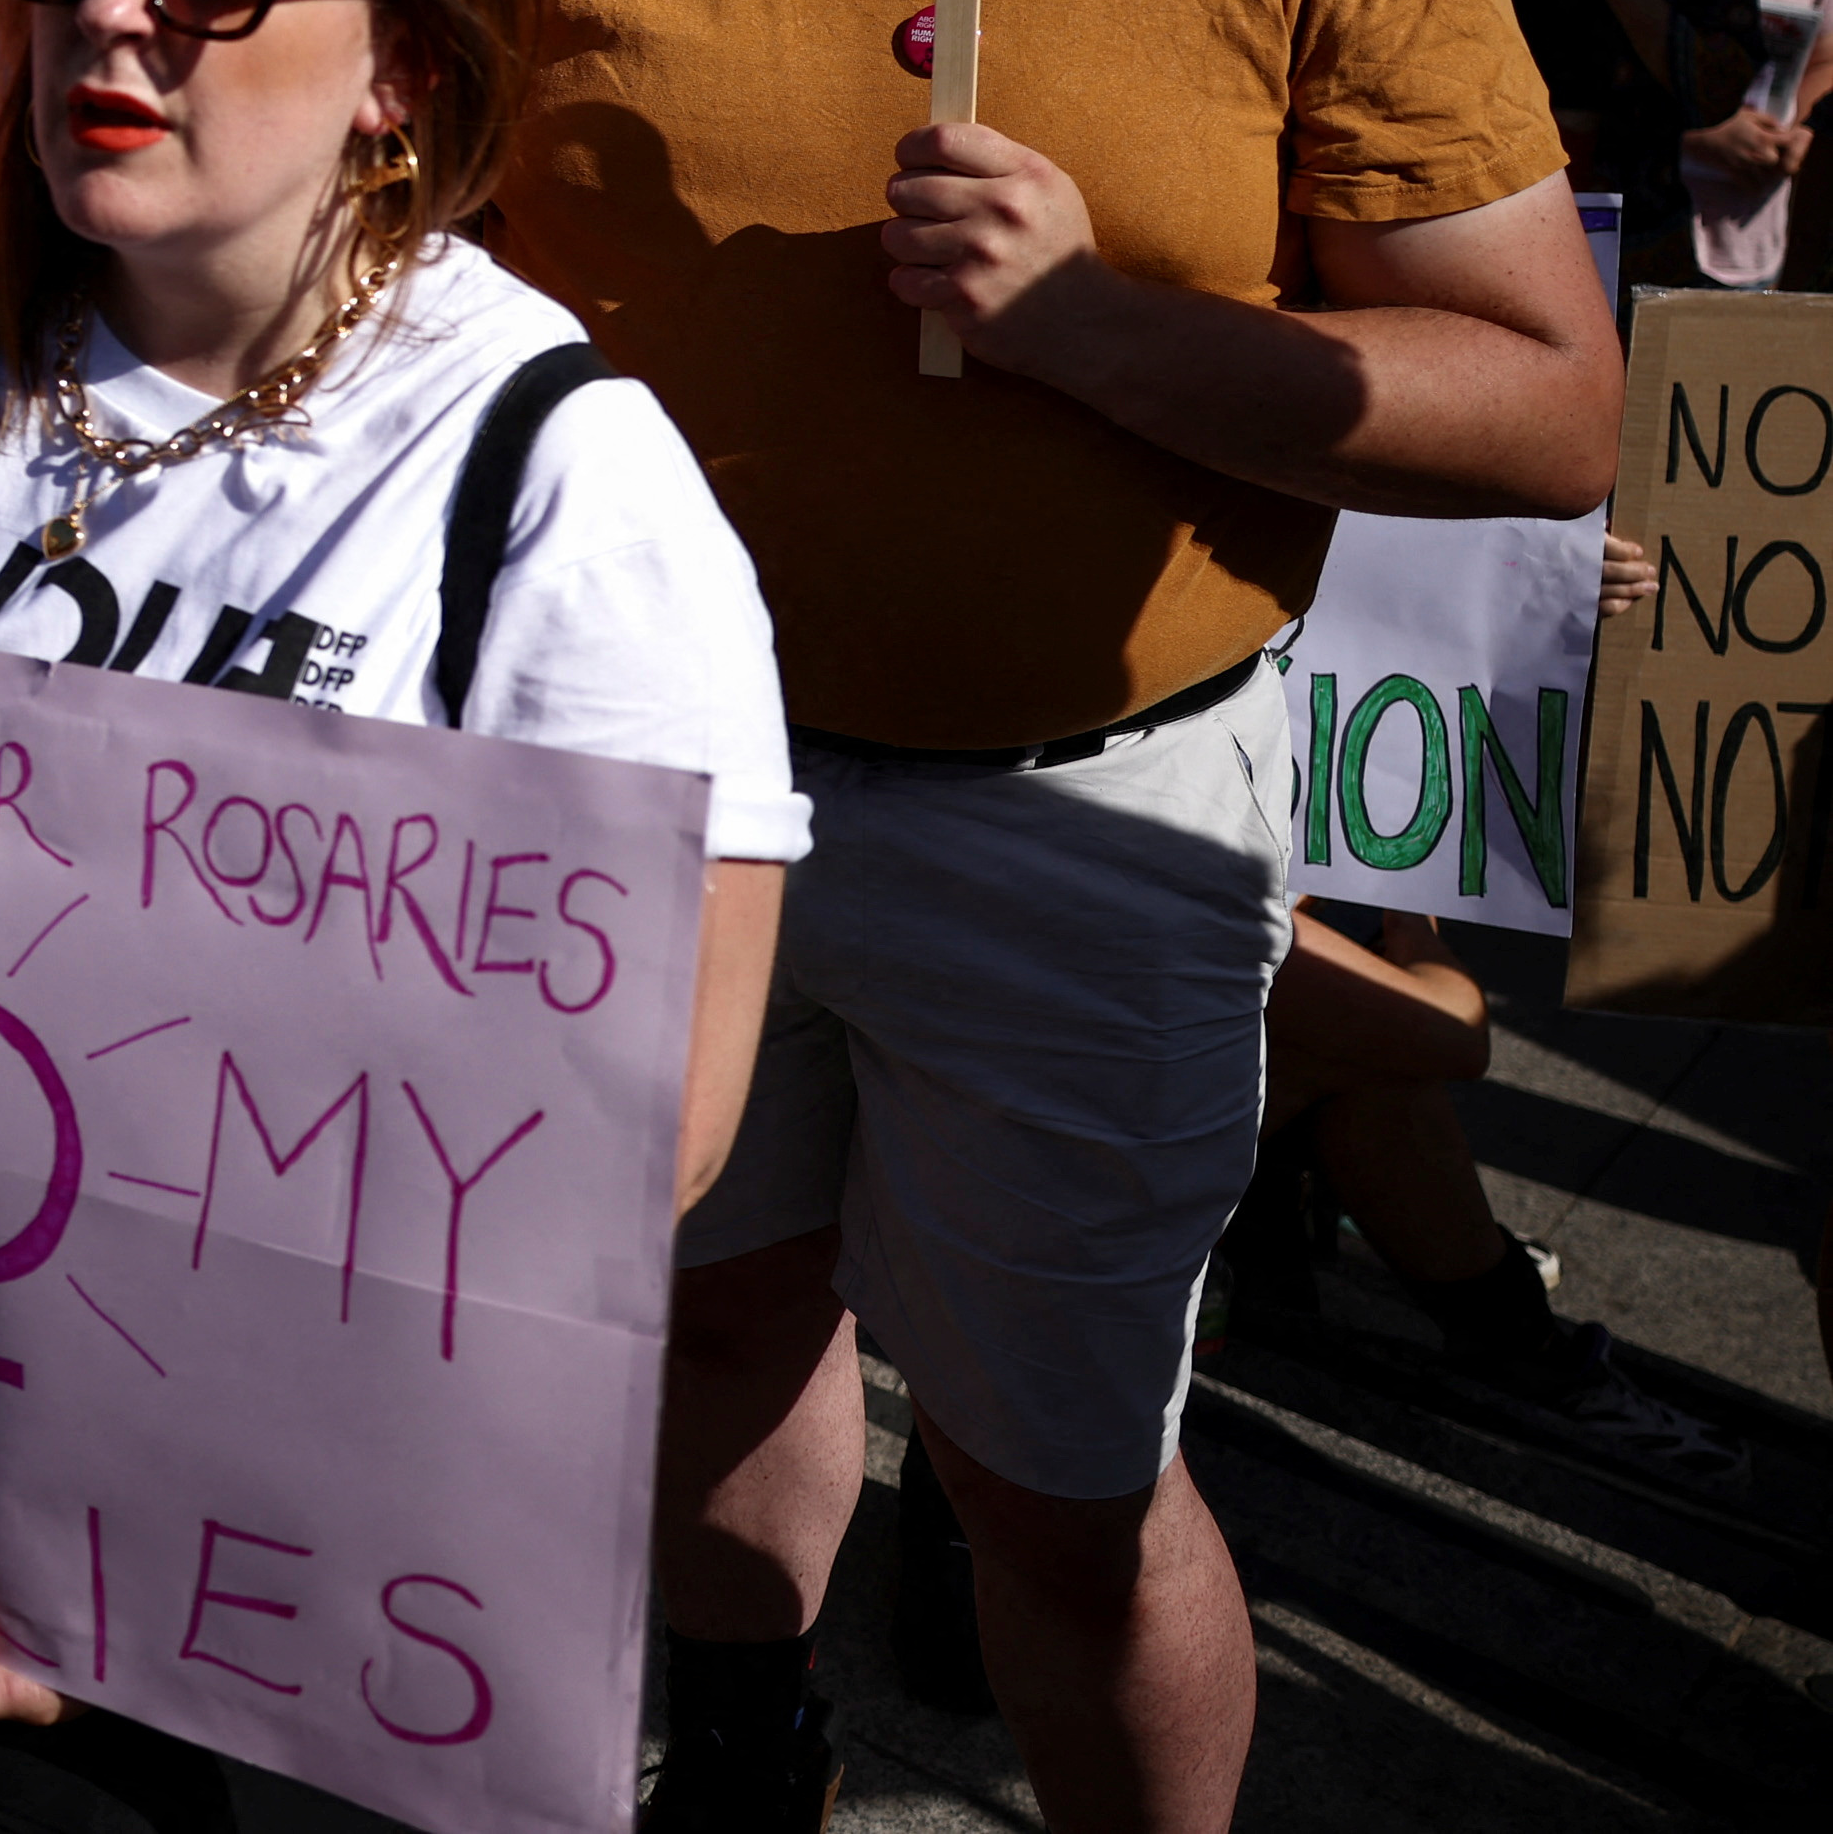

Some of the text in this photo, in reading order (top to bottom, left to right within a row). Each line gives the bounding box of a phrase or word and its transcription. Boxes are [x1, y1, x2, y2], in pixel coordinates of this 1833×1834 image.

[911, 35, 933, 43] RIGH
[917, 21, 934, 29] RIGH
[1665, 381, 1833, 497] NO
[315, 625, 367, 657] DFP
[1651, 535, 1826, 656] NO
[302, 667, 355, 693] DFP
[1291, 674, 1568, 909] ION
[141, 759, 629, 1015] ROSARIES
[192, 1051, 543, 1360] MY
